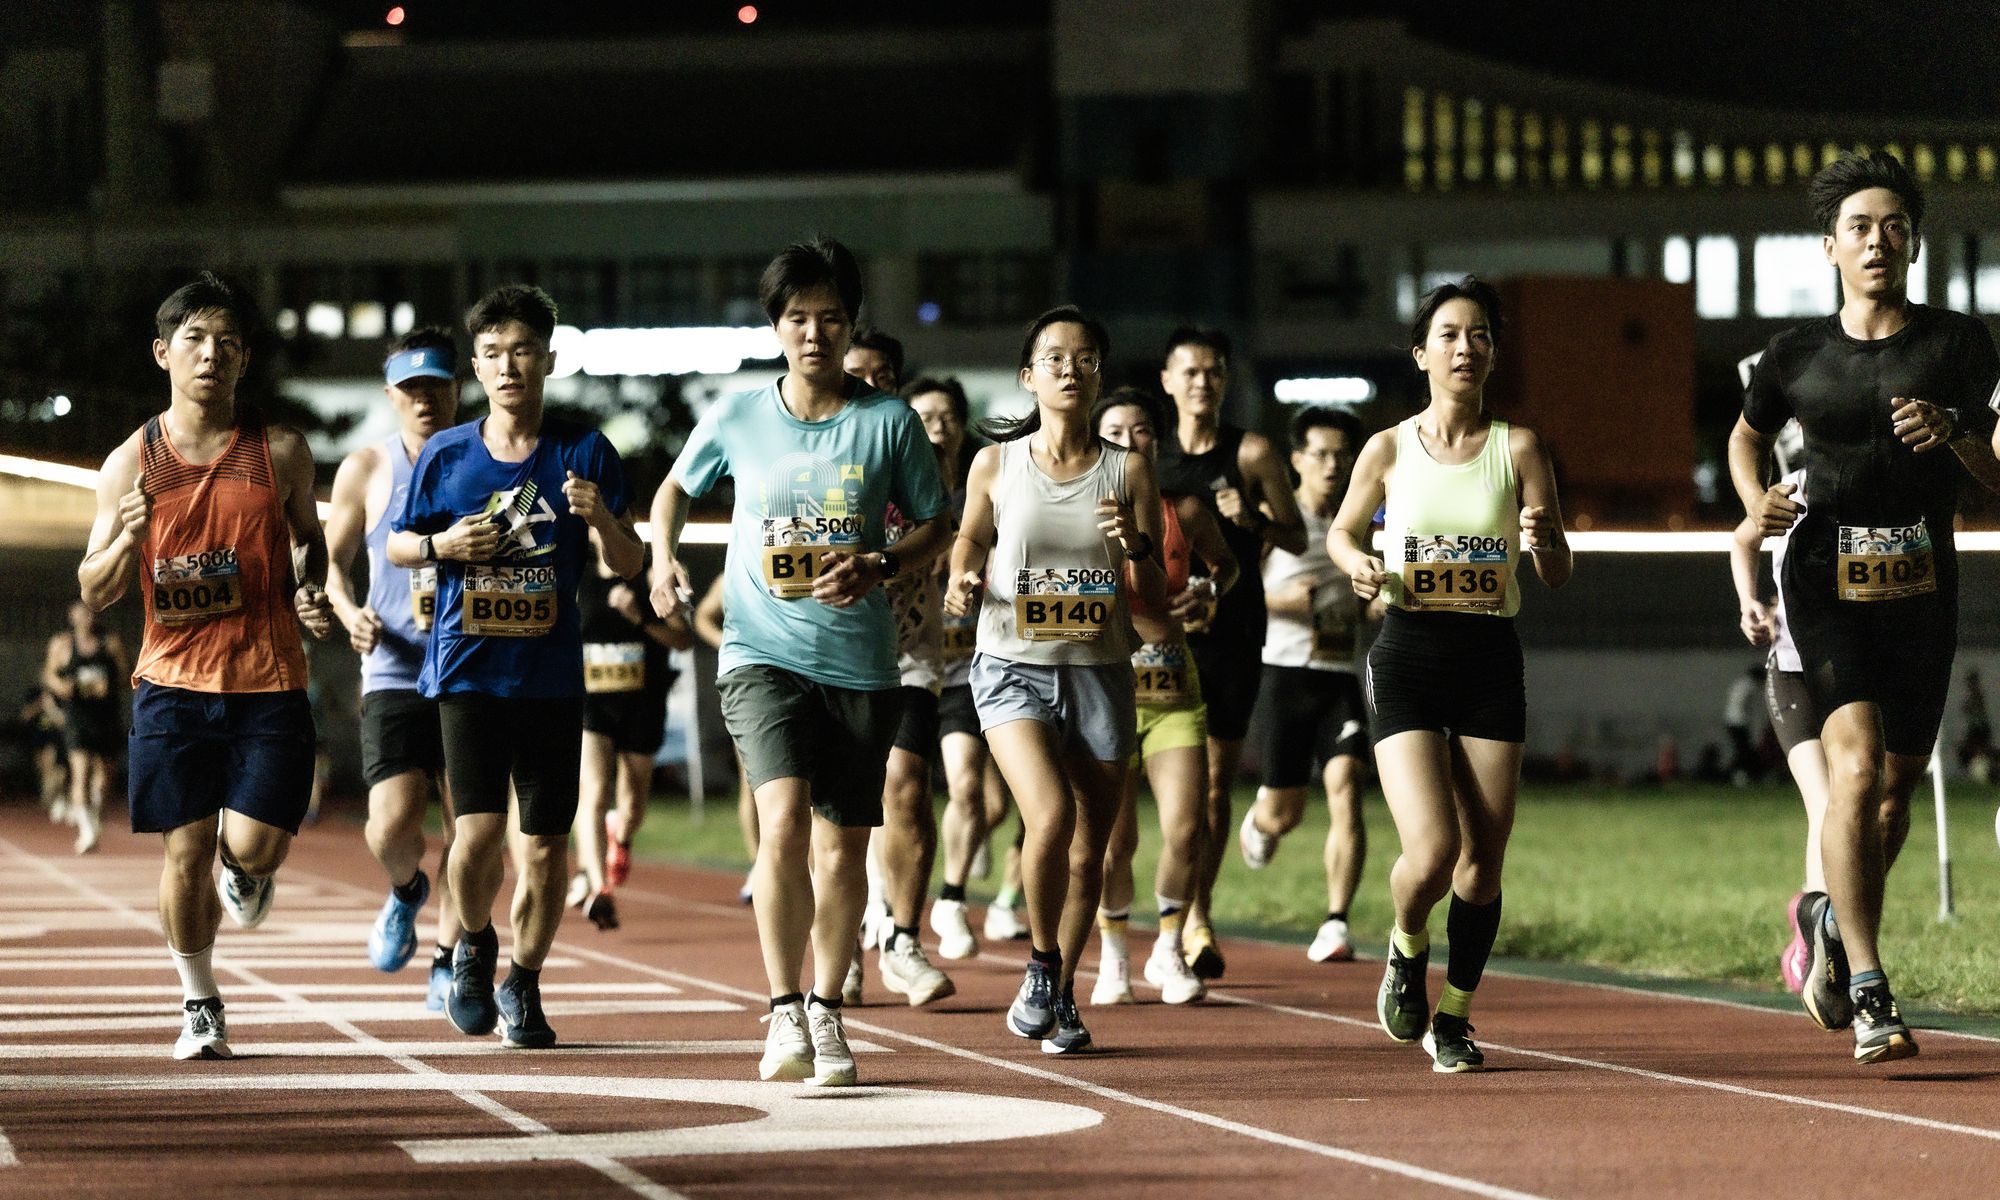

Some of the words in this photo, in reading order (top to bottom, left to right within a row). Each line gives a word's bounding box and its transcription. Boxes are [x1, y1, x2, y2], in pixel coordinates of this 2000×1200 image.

[1405, 537, 1418, 562] 高雄
[1457, 536, 1507, 552] 5000
[187, 549, 236, 570] 5000
[513, 568, 556, 583] 5000
[1017, 569, 1030, 594] 高雄
[1067, 569, 1115, 584] 5000
[1414, 570, 1498, 593] B136
[155, 582, 233, 610] B004
[473, 598, 550, 621] B095
[1026, 601, 1107, 624] B140
[1135, 671, 1185, 690] 121
